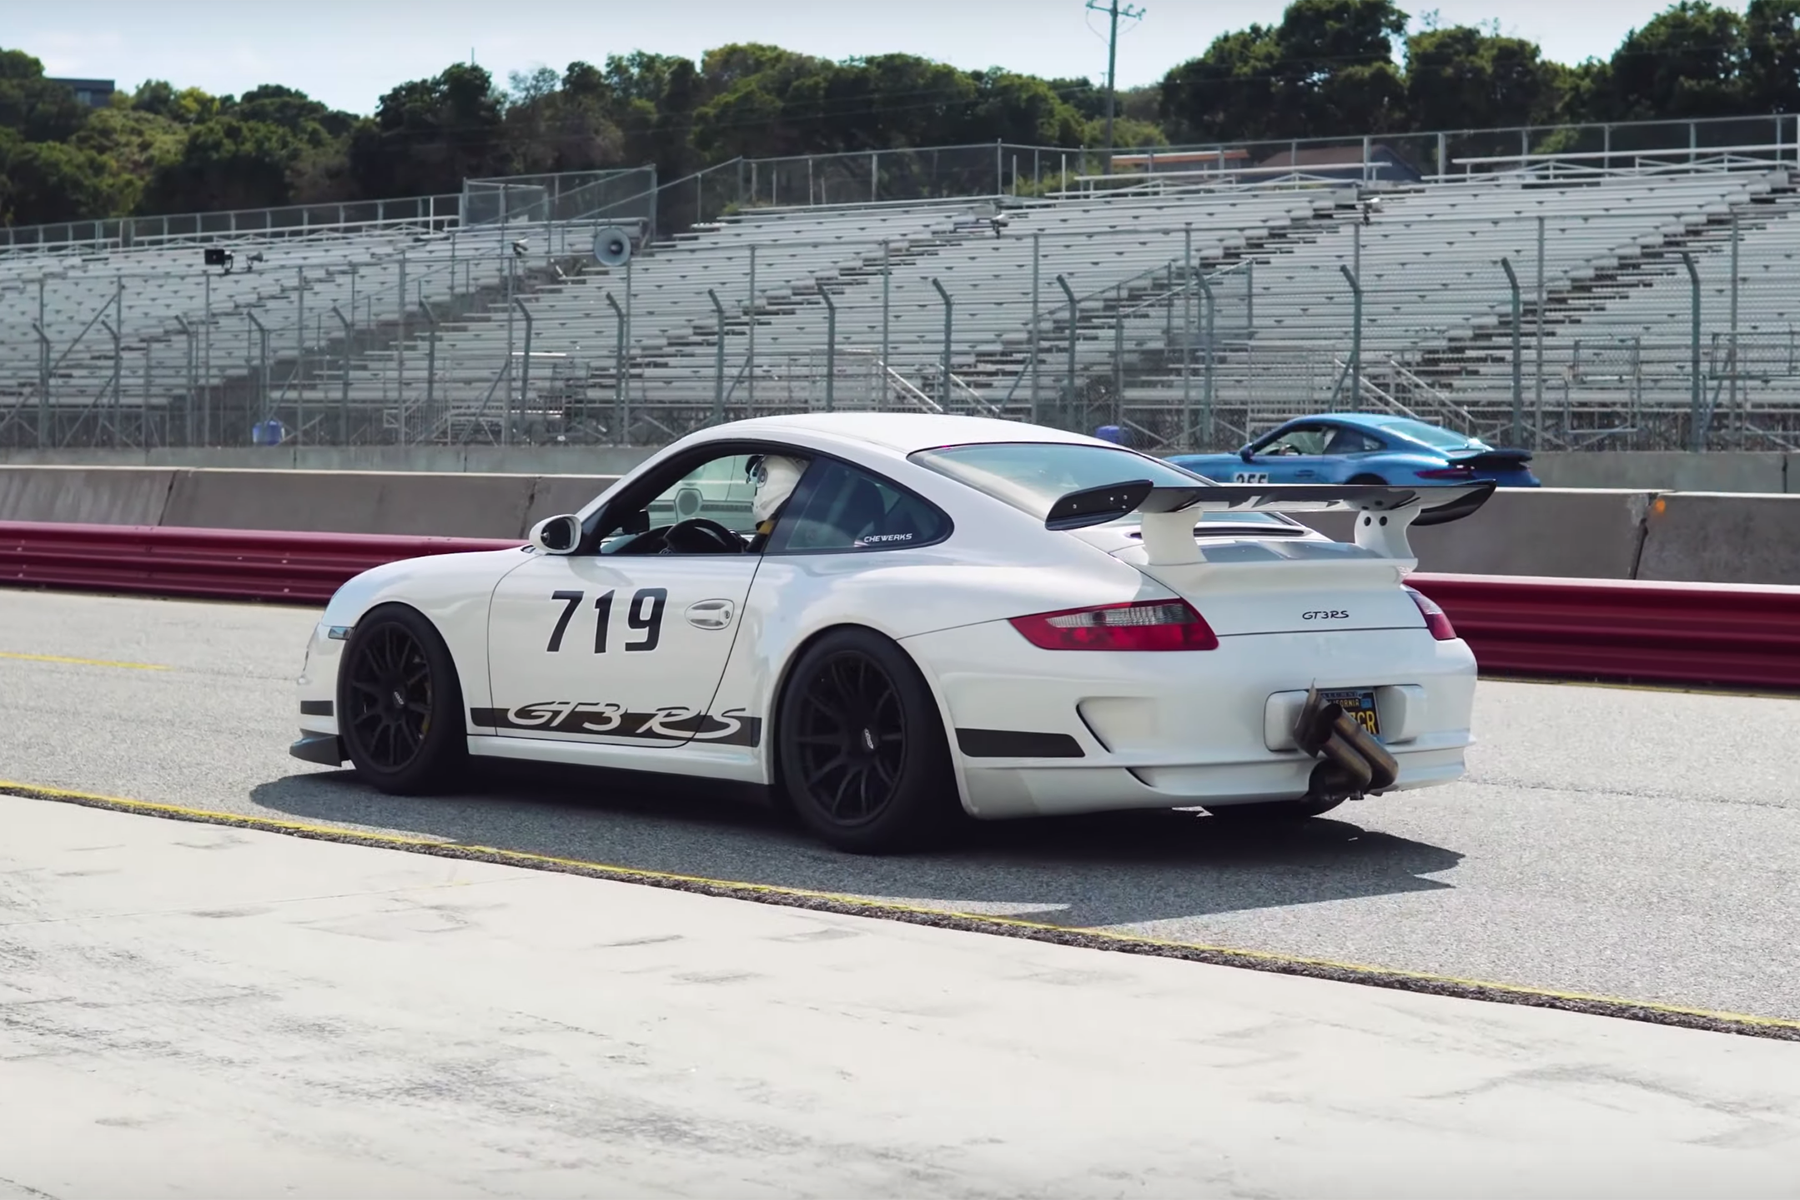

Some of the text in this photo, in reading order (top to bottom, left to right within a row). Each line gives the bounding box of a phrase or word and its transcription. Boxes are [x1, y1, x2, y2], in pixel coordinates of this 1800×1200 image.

[864, 533, 913, 543] CHEWERKS
[546, 587, 668, 654] 719
[507, 701, 747, 740] GT3 RS
